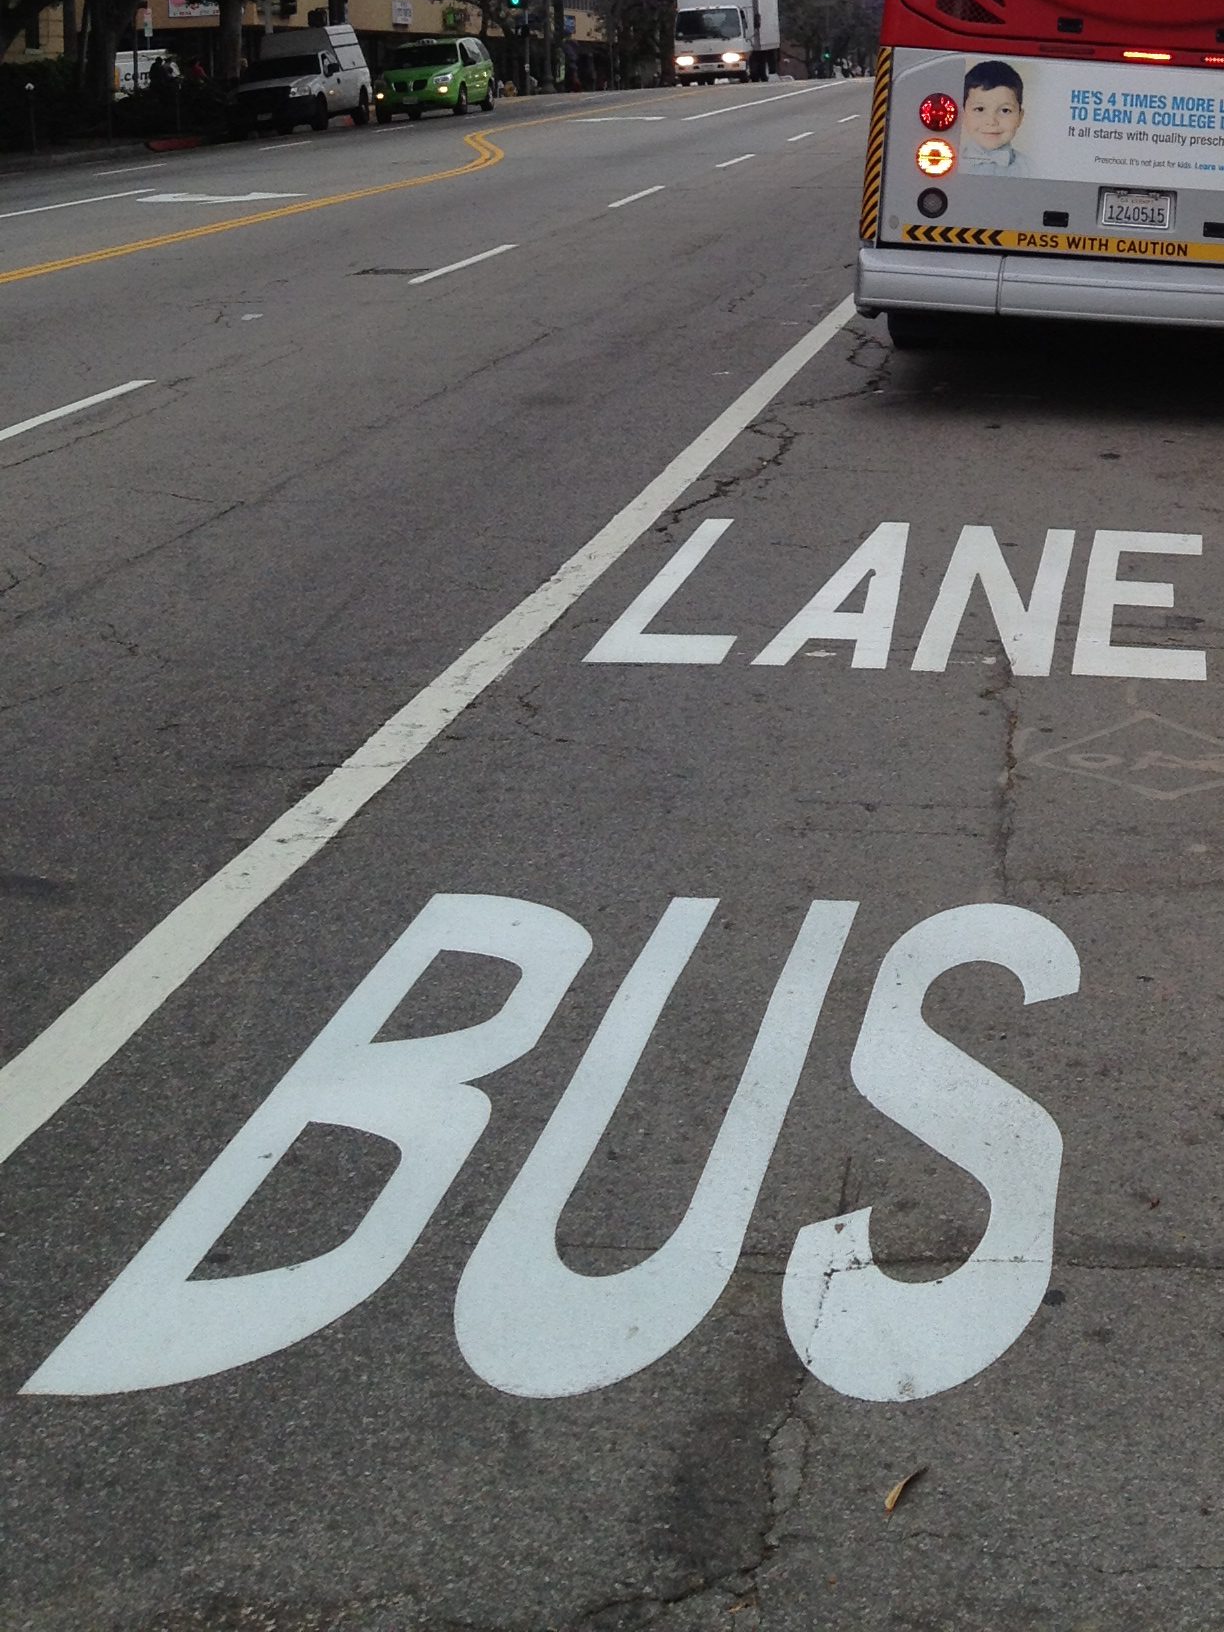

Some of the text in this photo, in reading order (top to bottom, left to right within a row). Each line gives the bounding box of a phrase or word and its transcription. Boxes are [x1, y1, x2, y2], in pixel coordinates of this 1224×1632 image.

[1070, 89, 1103, 106] HE'S
[1107, 92, 1117, 106] 4
[1121, 92, 1167, 110] TIMES
[1171, 96, 1215, 113] MORE
[1070, 106, 1088, 121] TO
[1093, 108, 1132, 125] EARN
[1136, 109, 1148, 125] A
[1151, 111, 1215, 129] COLLEGE
[1068, 126, 1075, 137] It
[1077, 127, 1091, 138] all
[1093, 128, 1124, 141] starts
[1126, 130, 1149, 142] with
[1151, 132, 1187, 147] quality
[1107, 204, 1165, 223] 1240515
[1016, 232, 1188, 257] PASS WITH CAUTION
[582, 517, 1208, 681] LANE
[15, 892, 1082, 1403] BUS
